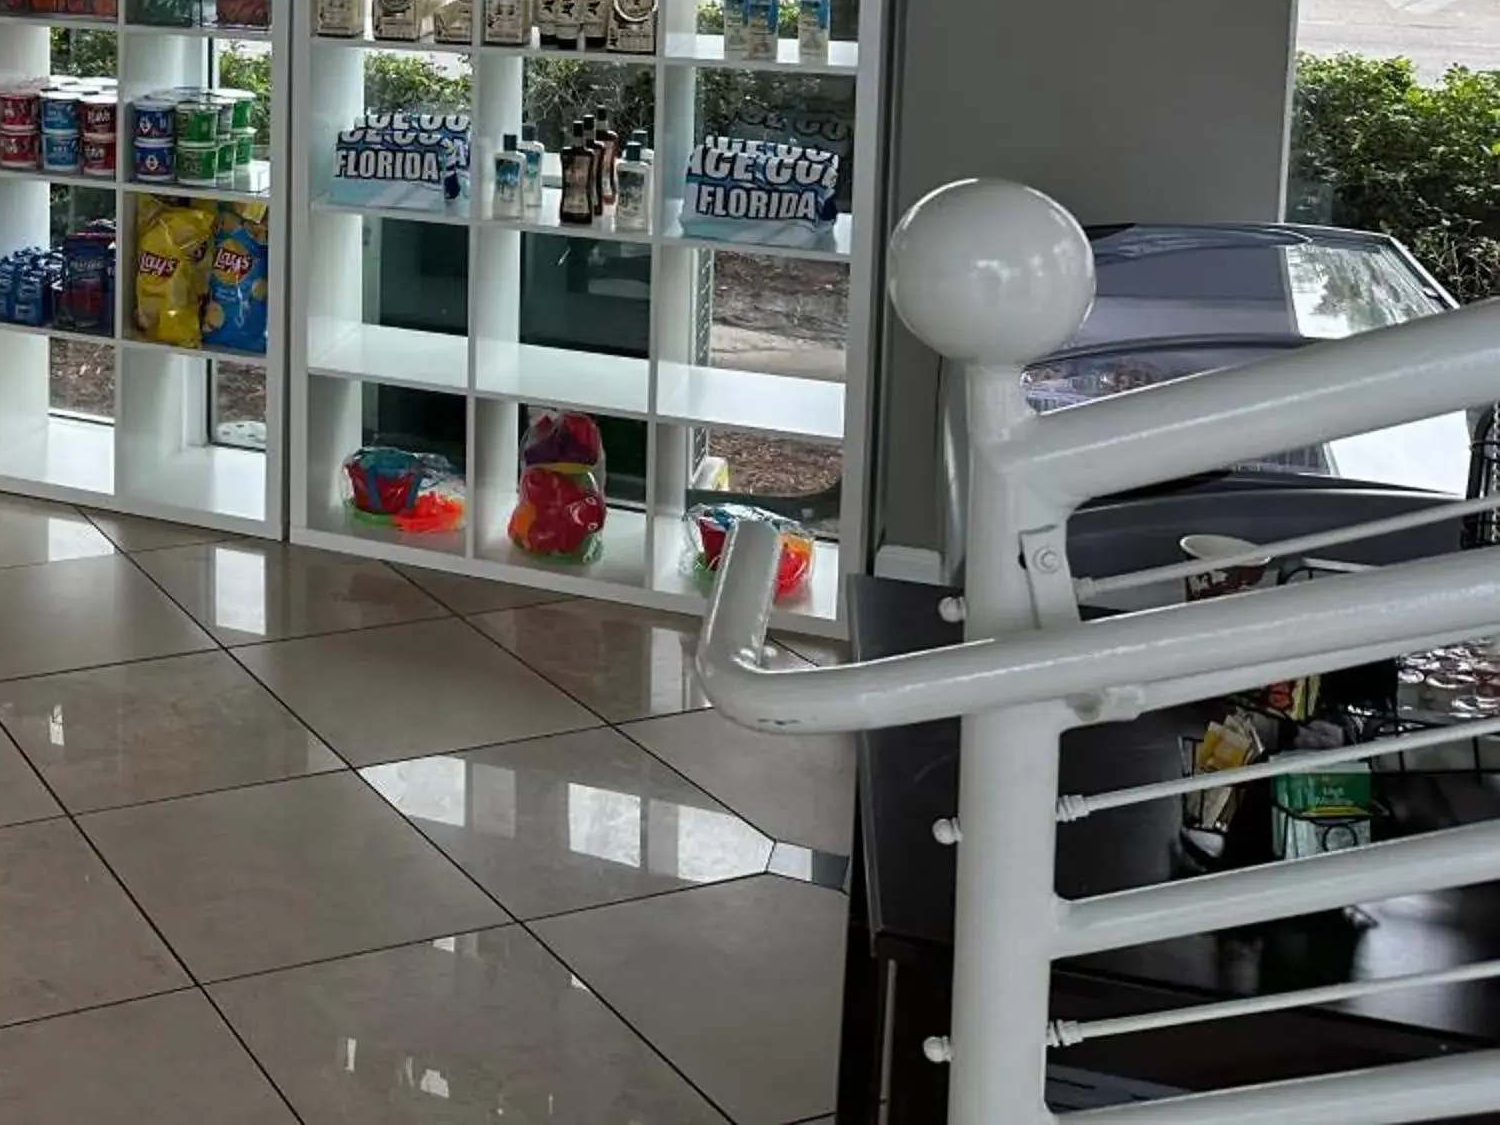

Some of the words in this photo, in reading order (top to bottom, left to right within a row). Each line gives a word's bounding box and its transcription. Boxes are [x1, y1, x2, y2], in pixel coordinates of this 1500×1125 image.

[333, 149, 440, 181] FLORIDA
[697, 185, 816, 220] FLORIDA
[138, 251, 177, 275] Lay's
[213, 248, 251, 273] Lay's
